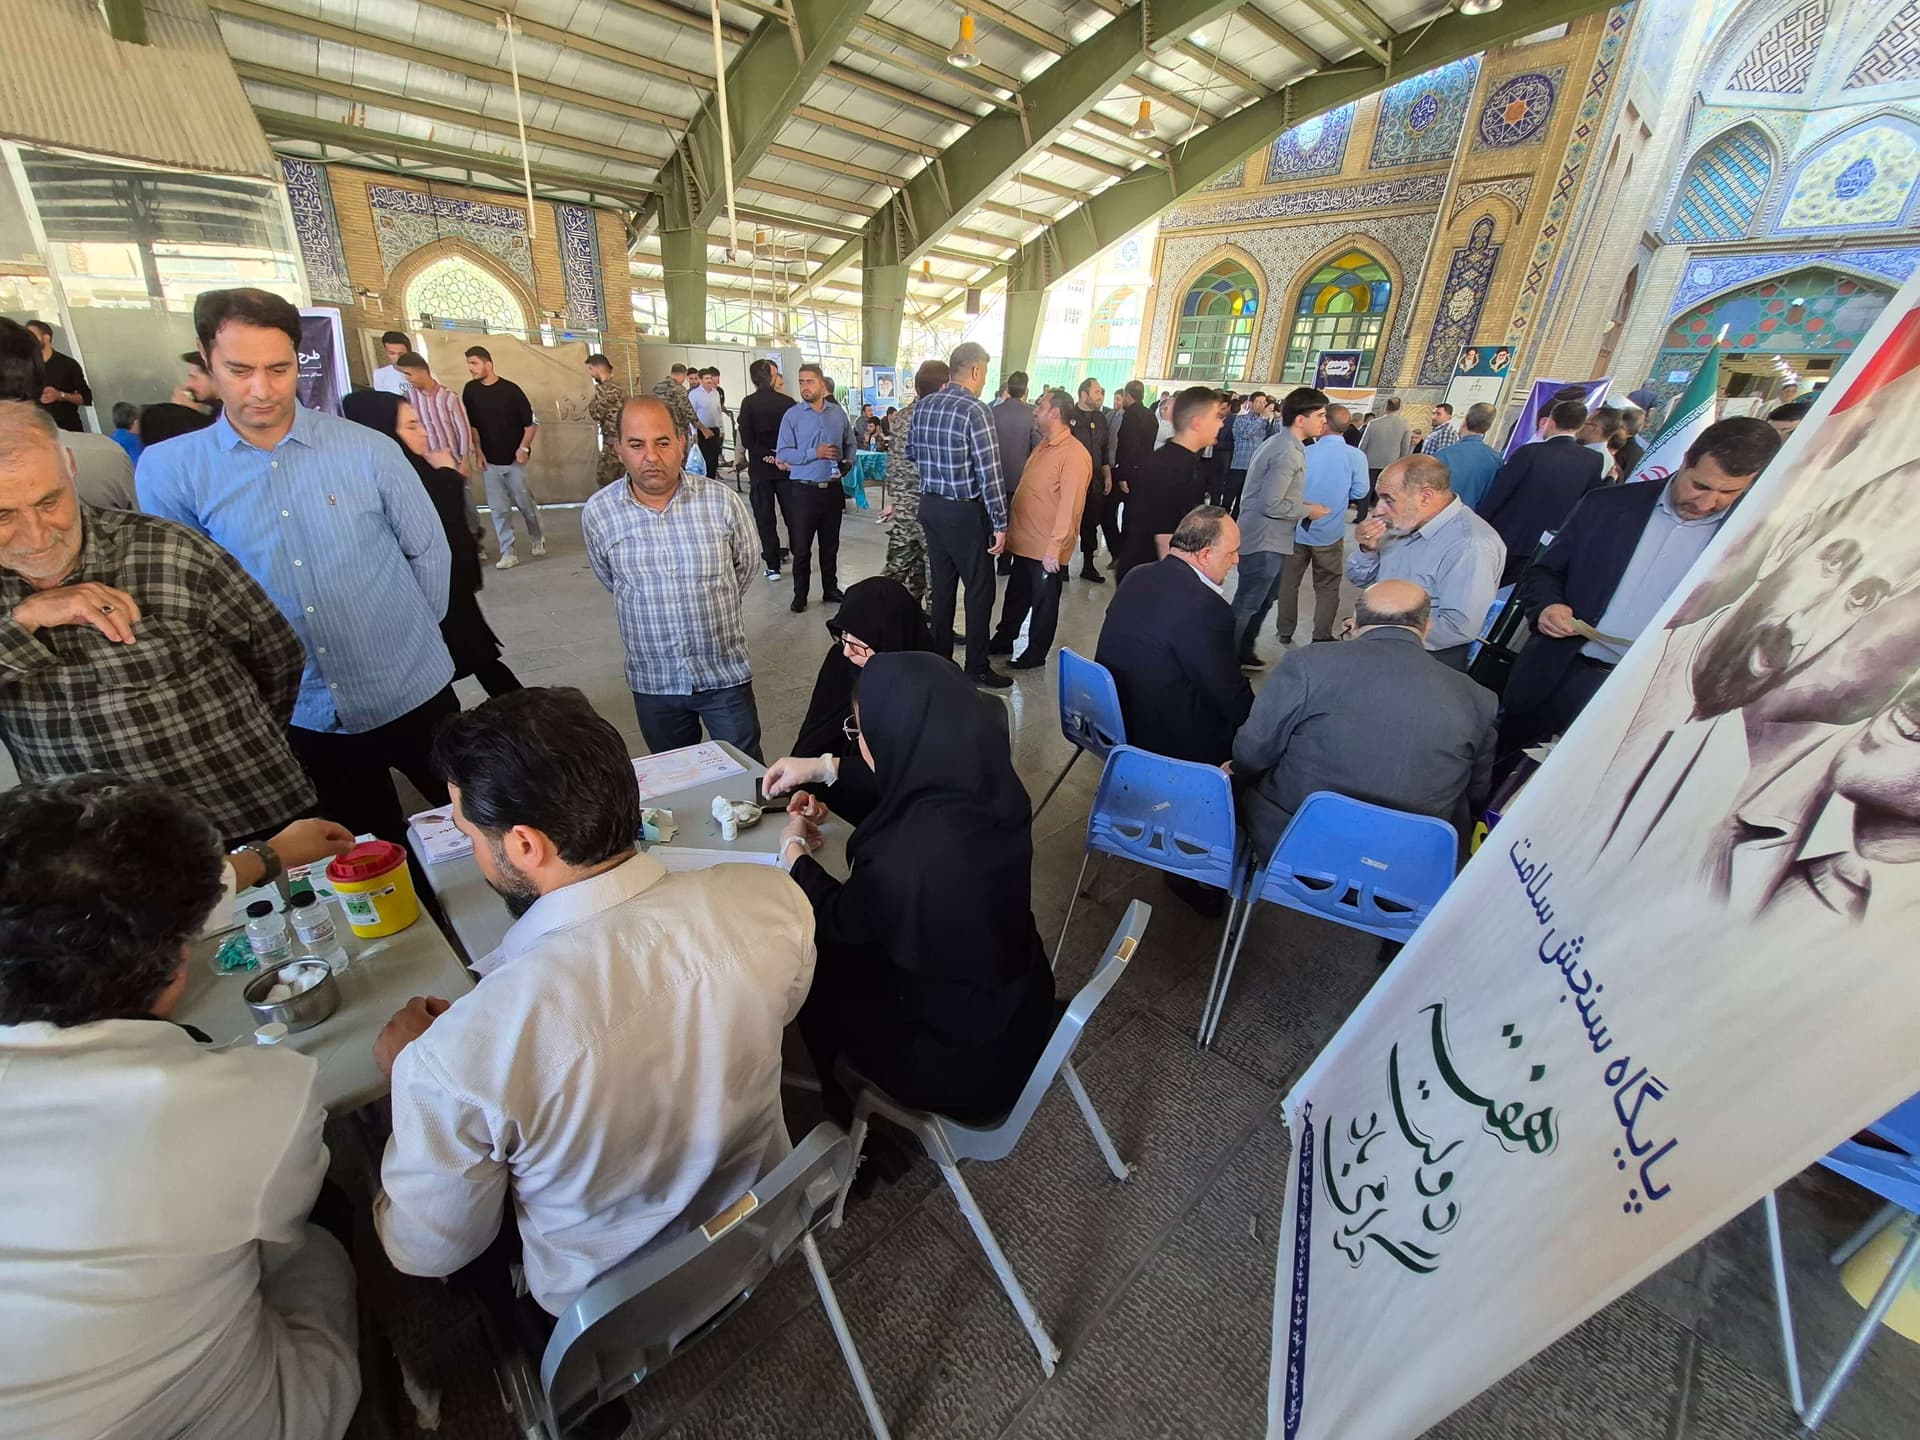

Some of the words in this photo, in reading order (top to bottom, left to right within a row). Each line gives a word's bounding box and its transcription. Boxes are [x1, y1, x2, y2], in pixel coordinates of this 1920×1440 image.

[298, 349, 321, 364] طرح
[1510, 837, 1554, 925] سلامت
[1539, 927, 1613, 1054] سنجش
[1341, 1112, 1387, 1178] باد
[1388, 1042, 1463, 1234] دولت
[1418, 998, 1558, 1154] هفته
[1604, 1055, 1678, 1214] پایگاه
[1323, 1115, 1440, 1274] گرامی
